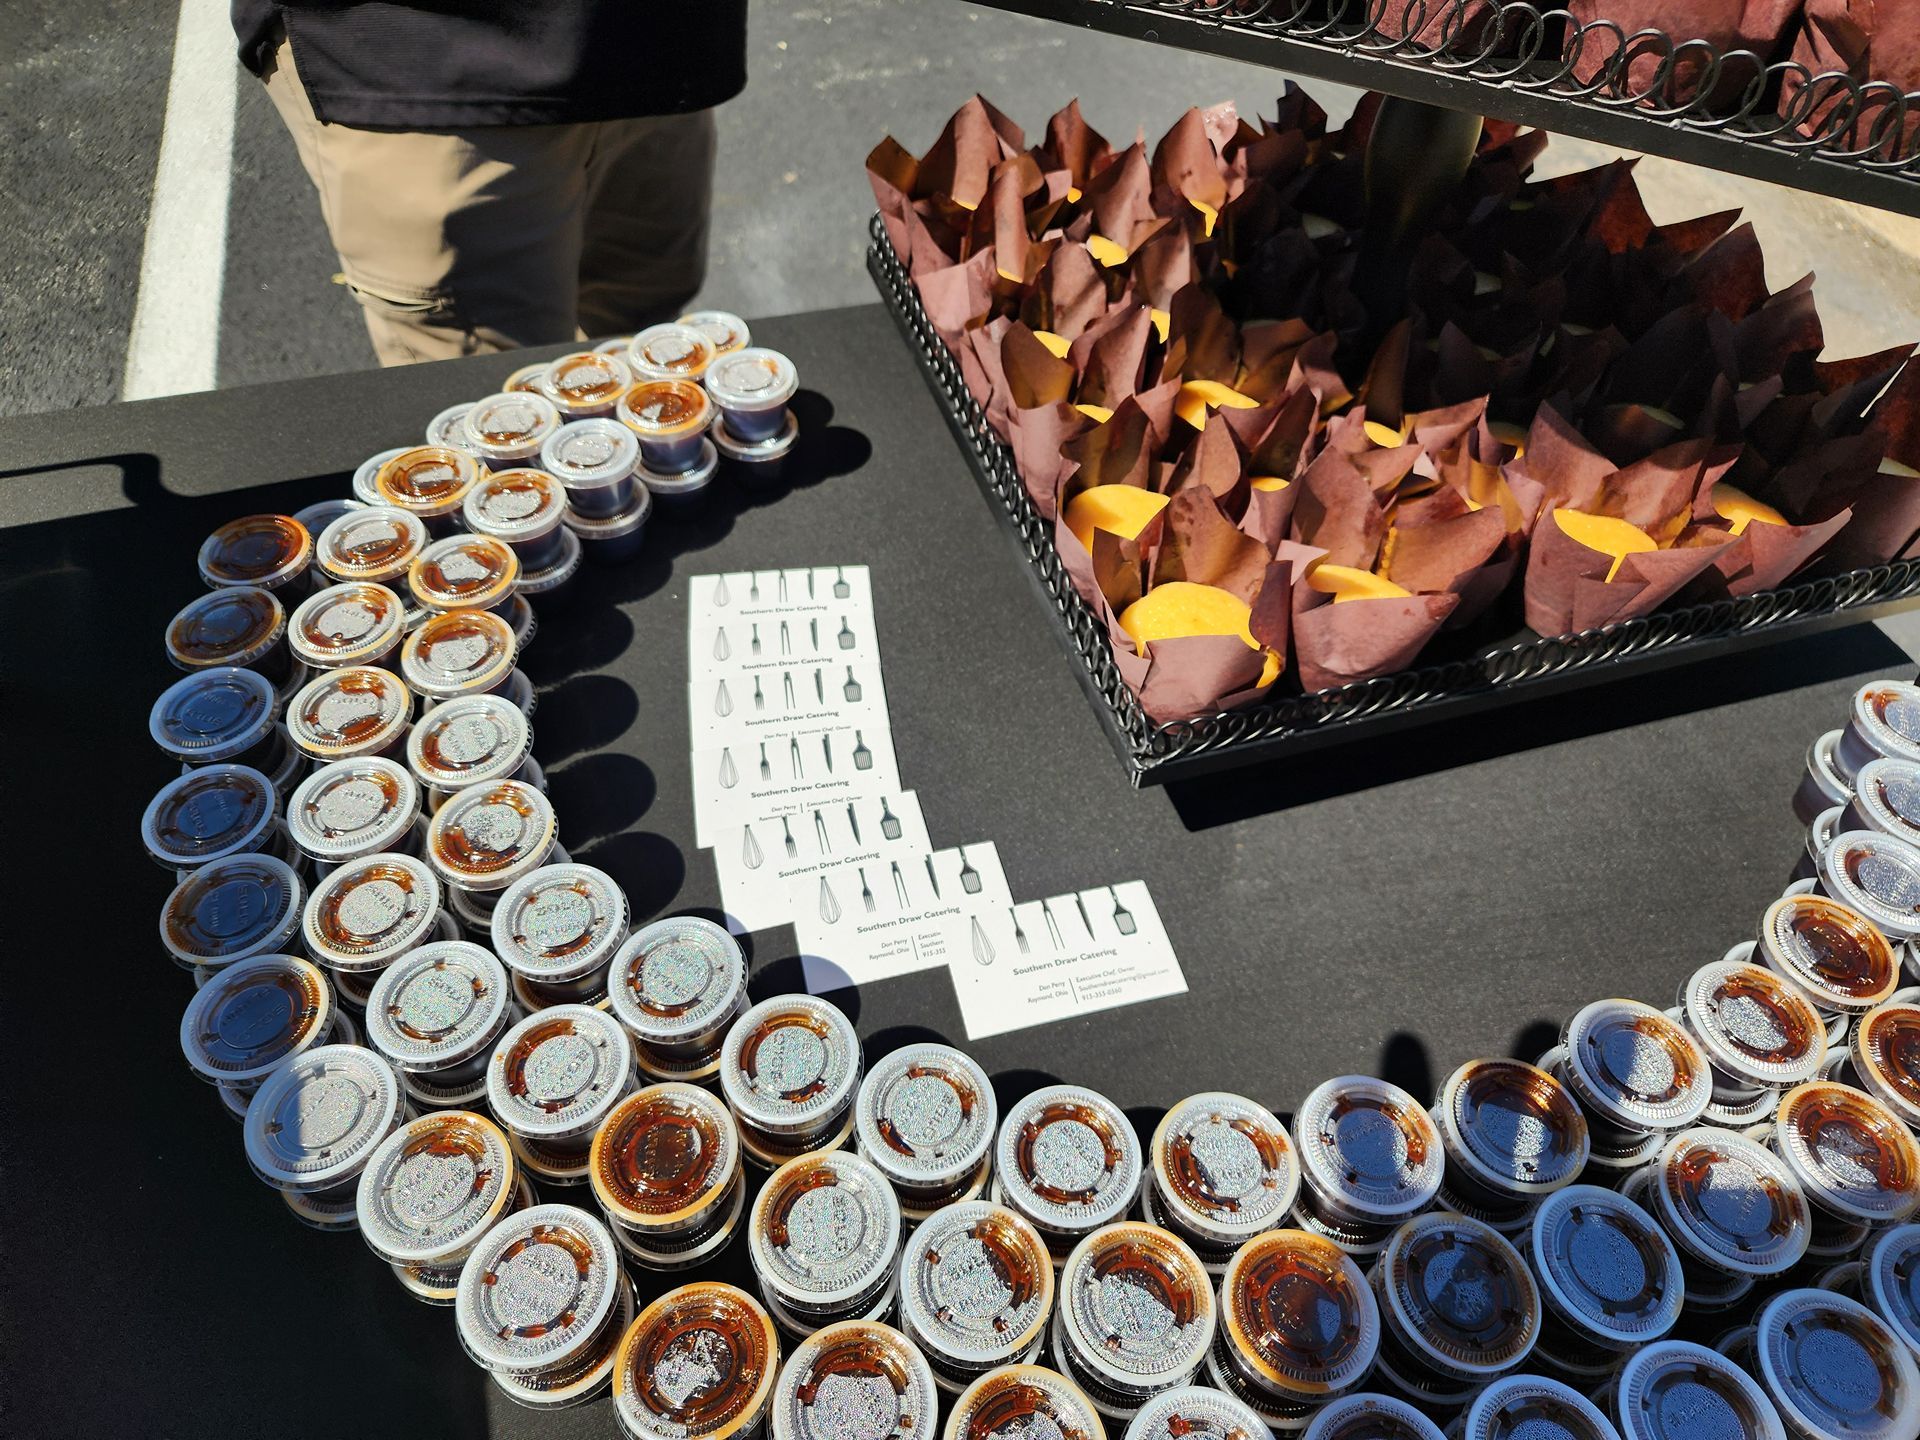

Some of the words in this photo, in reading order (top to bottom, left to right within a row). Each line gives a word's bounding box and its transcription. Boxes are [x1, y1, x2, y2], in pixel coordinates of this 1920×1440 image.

[739, 608, 774, 616] Southern
[775, 606, 795, 614] Draw
[796, 604, 828, 612] Catering
[741, 662, 777, 671] Southern
[778, 660, 799, 668] Draw
[801, 657, 833, 665] Catering
[744, 717, 781, 727] Southern
[782, 714, 804, 723] Draw
[806, 710, 840, 719] Catering
[750, 788, 790, 799] Southern
[790, 785, 813, 794] Draw
[814, 780, 850, 791] Catering
[806, 800, 831, 808] Executive
[778, 866, 818, 879] Southern
[819, 859, 843, 869] Draw
[844, 851, 881, 864] Catering
[857, 920, 897, 934] Southern
[898, 914, 922, 925] Draw
[924, 906, 962, 919] Catering
[881, 941, 893, 949] Don
[893, 938, 908, 947] Perry
[896, 947, 910, 955] Ohio
[1013, 961, 1054, 976] Southern
[1054, 955, 1078, 968] Draw
[1079, 947, 1118, 961] Catering
[1075, 972, 1102, 983] Executive
[1117, 965, 1136, 974] Owner
[1039, 983, 1051, 992] Don
[1051, 981, 1066, 990] Perry
[1054, 989, 1069, 998] Ohio
